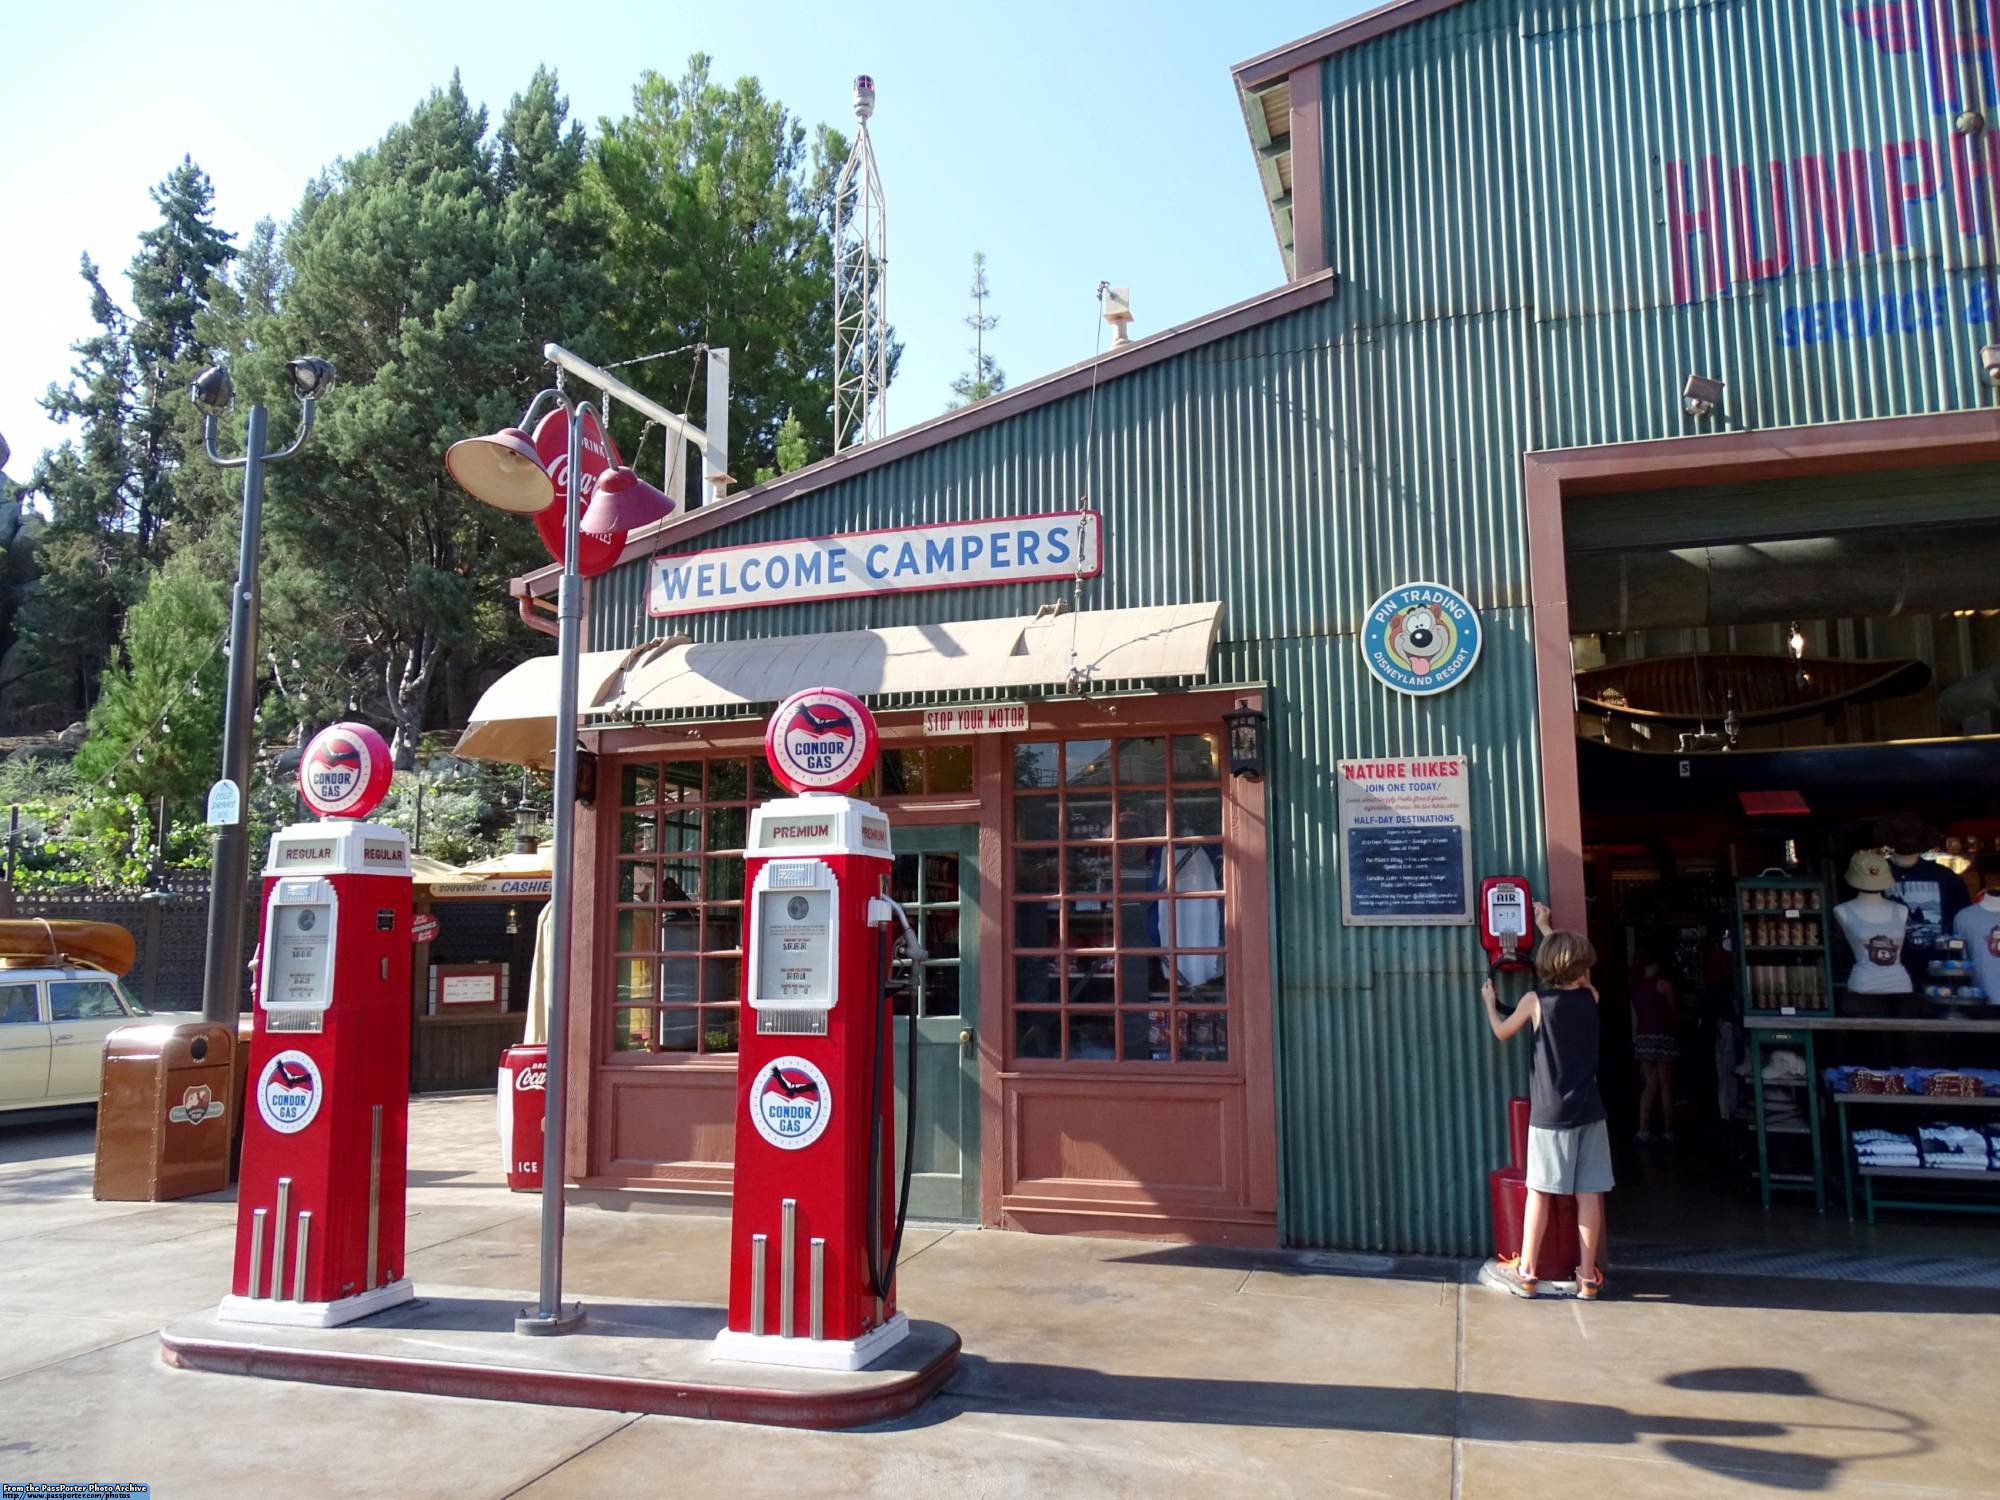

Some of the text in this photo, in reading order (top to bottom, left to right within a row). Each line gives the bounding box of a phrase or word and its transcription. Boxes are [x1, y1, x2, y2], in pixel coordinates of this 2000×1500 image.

[1777, 287, 1948, 347] SERVICE
[662, 527, 1070, 600] WELCOME CAMPERS
[1375, 590, 1466, 623] PIN TRADING
[1373, 647, 1469, 686] DISNEYLAND RESORT
[927, 706, 1024, 732] STOP YOUR MOTOR
[795, 741, 844, 756] CONDOR
[807, 756, 831, 769] GAS
[1345, 761, 1459, 779] NATURE HIKES
[313, 772, 351, 785] CONDOR
[321, 785, 340, 797] GAS
[1365, 782, 1441, 792] JOIN ONE TODAY!
[1354, 814, 1454, 824] HALF-DAY DESTINATIONS
[773, 825, 829, 838] PREMIUM
[286, 848, 331, 860] REGULAR
[364, 848, 403, 861] REGULAR
[439, 880, 552, 893] SOUVENIRS CASHIE
[1497, 893, 1516, 902] AIR
[272, 1094, 306, 1106] CONDOR
[280, 1107, 297, 1118] GAS
[769, 1105, 812, 1119] CONDOR
[780, 1119, 800, 1132] GAS
[518, 1162, 538, 1173] ICE
